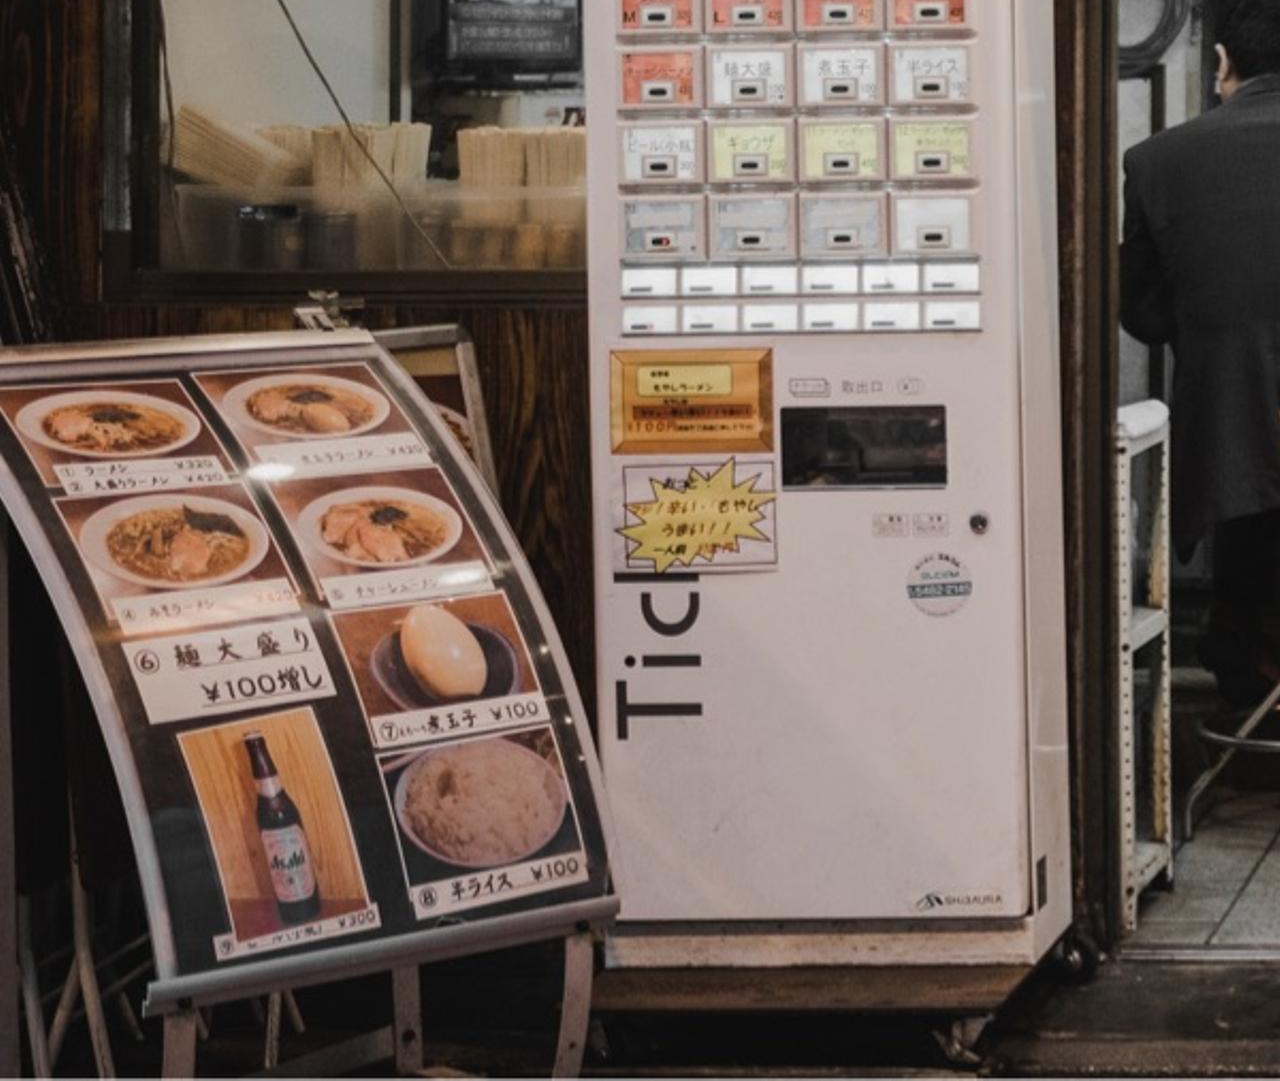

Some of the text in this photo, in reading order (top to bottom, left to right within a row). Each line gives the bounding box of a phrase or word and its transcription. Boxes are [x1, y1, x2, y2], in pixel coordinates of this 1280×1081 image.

[172, 625, 311, 669] 麺大盛り
[200, 663, 324, 704] ¥100増し
[489, 700, 539, 721] ¥100
[450, 871, 514, 902] 半ライス
[529, 857, 579, 882] ¥100
[338, 910, 376, 929] ¥300
